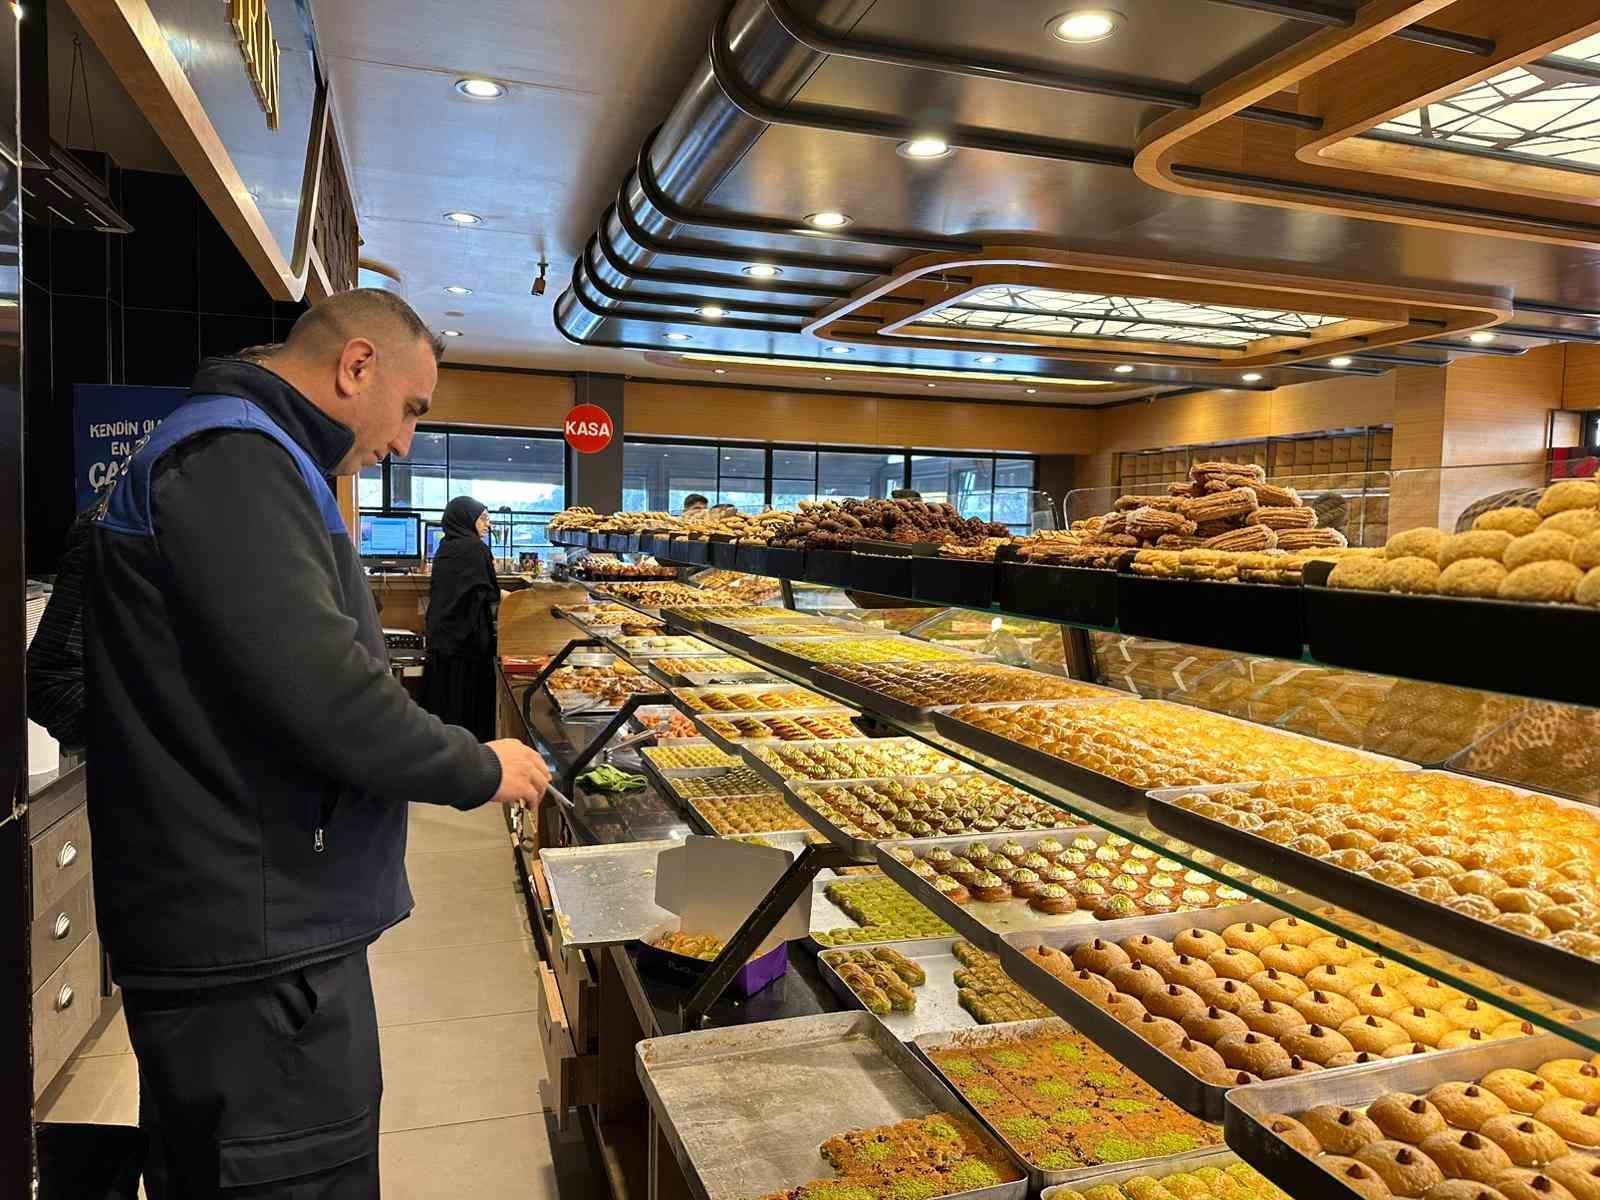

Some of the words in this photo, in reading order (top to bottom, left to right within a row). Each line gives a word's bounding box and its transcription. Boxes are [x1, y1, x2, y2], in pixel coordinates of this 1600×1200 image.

[89, 420, 138, 438] KENDİN
[565, 420, 610, 438] KASA
[111, 442, 131, 456] EN
